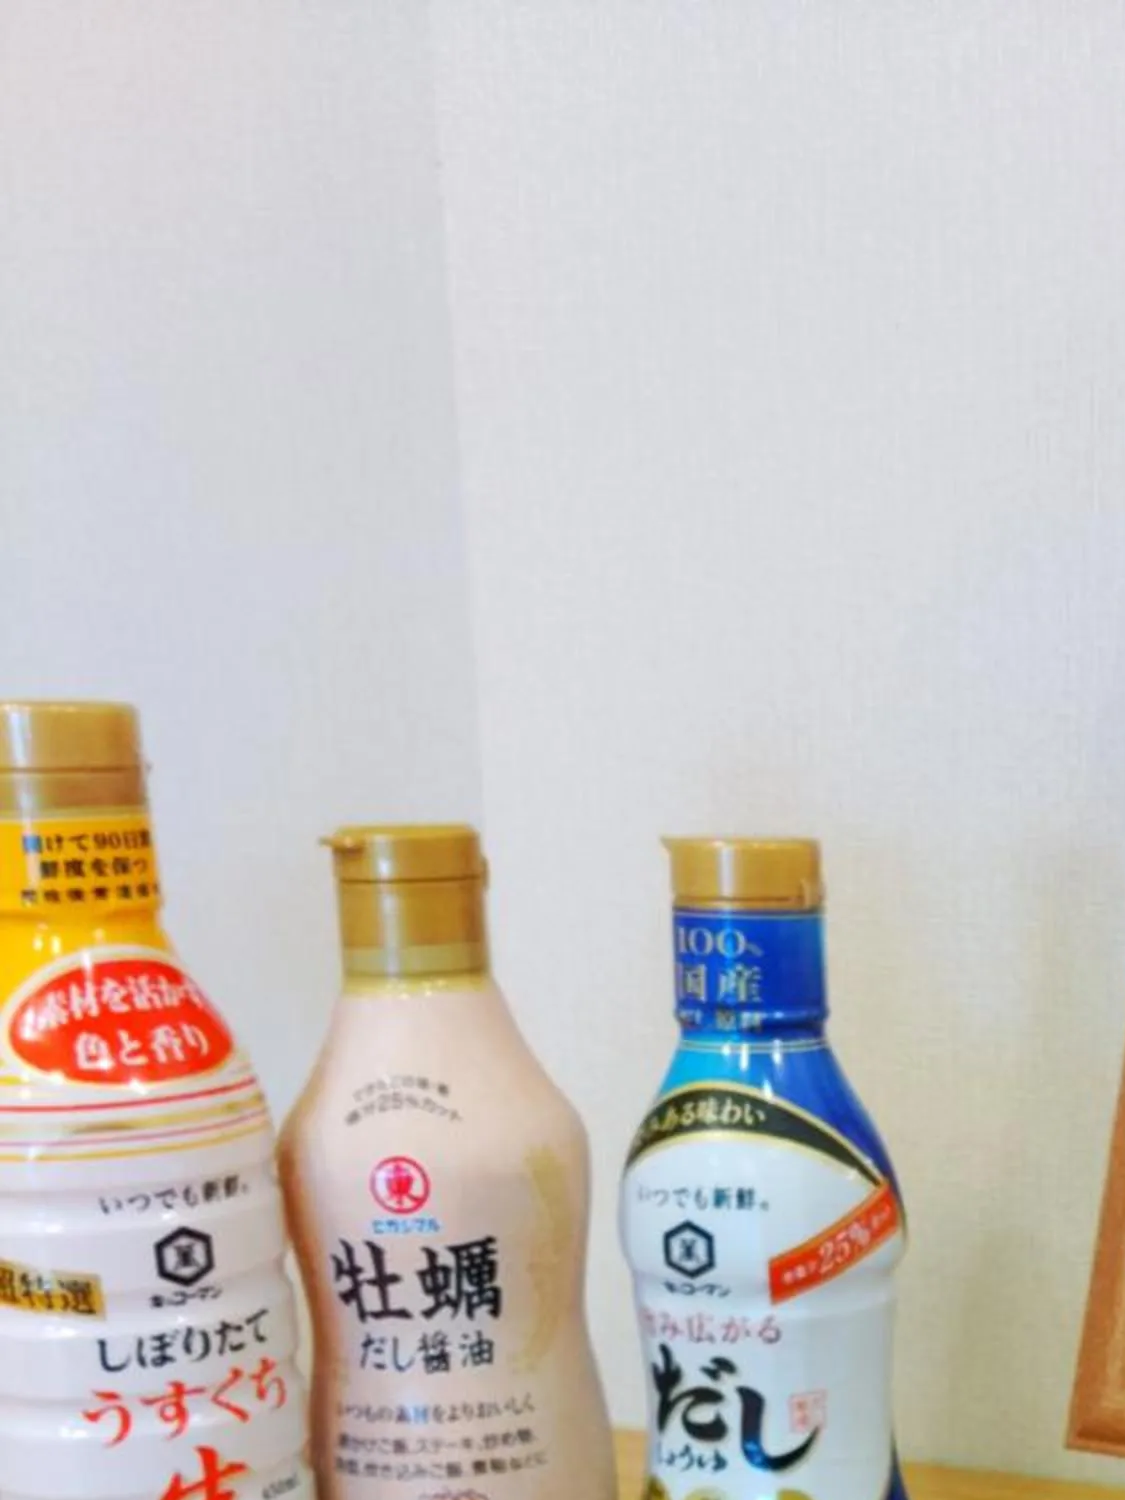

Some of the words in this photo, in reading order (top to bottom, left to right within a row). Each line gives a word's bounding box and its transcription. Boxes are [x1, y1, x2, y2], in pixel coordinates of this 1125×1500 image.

[74, 1023, 209, 1070] 色と香り
[331, 1236, 503, 1324] 牡蠣
[97, 1308, 269, 1373] しぼりたて
[360, 1331, 495, 1374] だし醤油
[82, 1356, 287, 1447] うすくち
[652, 1342, 820, 1472] だし
[656, 1443, 728, 1473] しょうゆ
